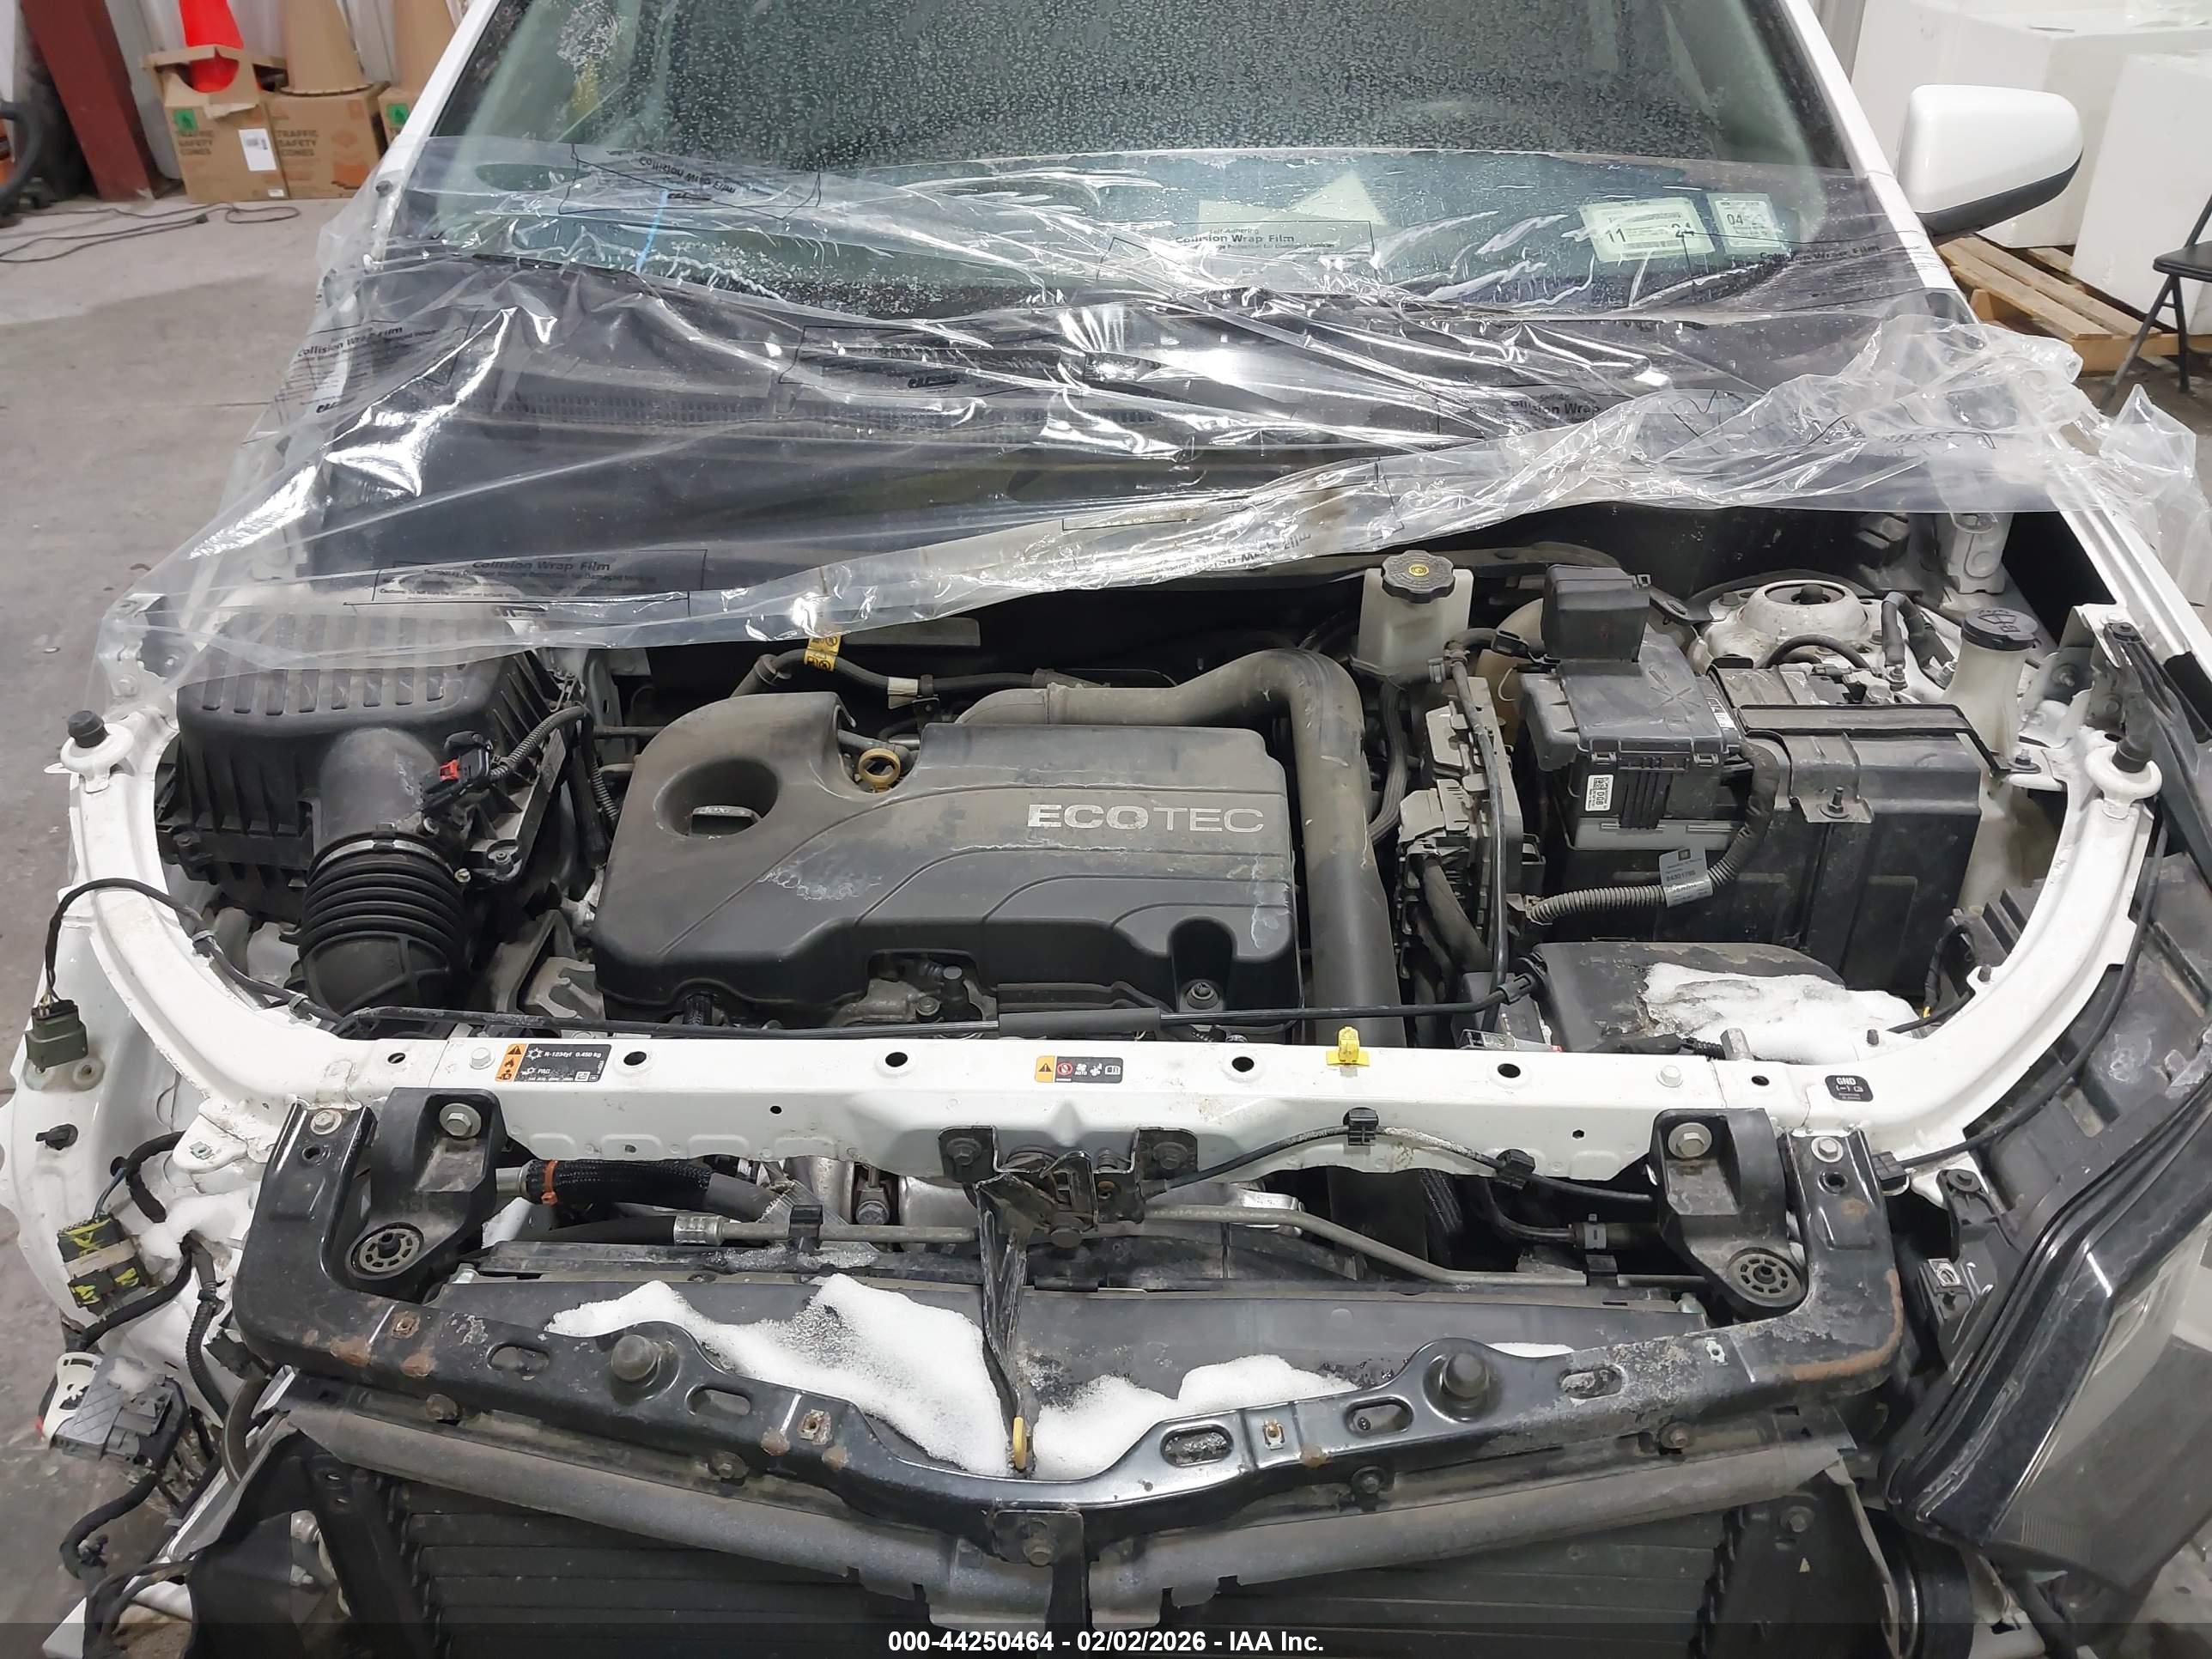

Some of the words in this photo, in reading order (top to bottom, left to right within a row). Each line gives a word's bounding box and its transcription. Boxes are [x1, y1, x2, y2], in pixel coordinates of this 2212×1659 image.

[1727, 214, 1743, 225] 04
[1231, 234, 1263, 244] Wrap
[1564, 403, 1601, 416] Wrap
[473, 561, 532, 569] Collision
[538, 561, 573, 571] Wrap
[580, 562, 610, 571] Film
[1028, 805, 1264, 833] ECOTEC
[1836, 1077, 1856, 1085] GND
